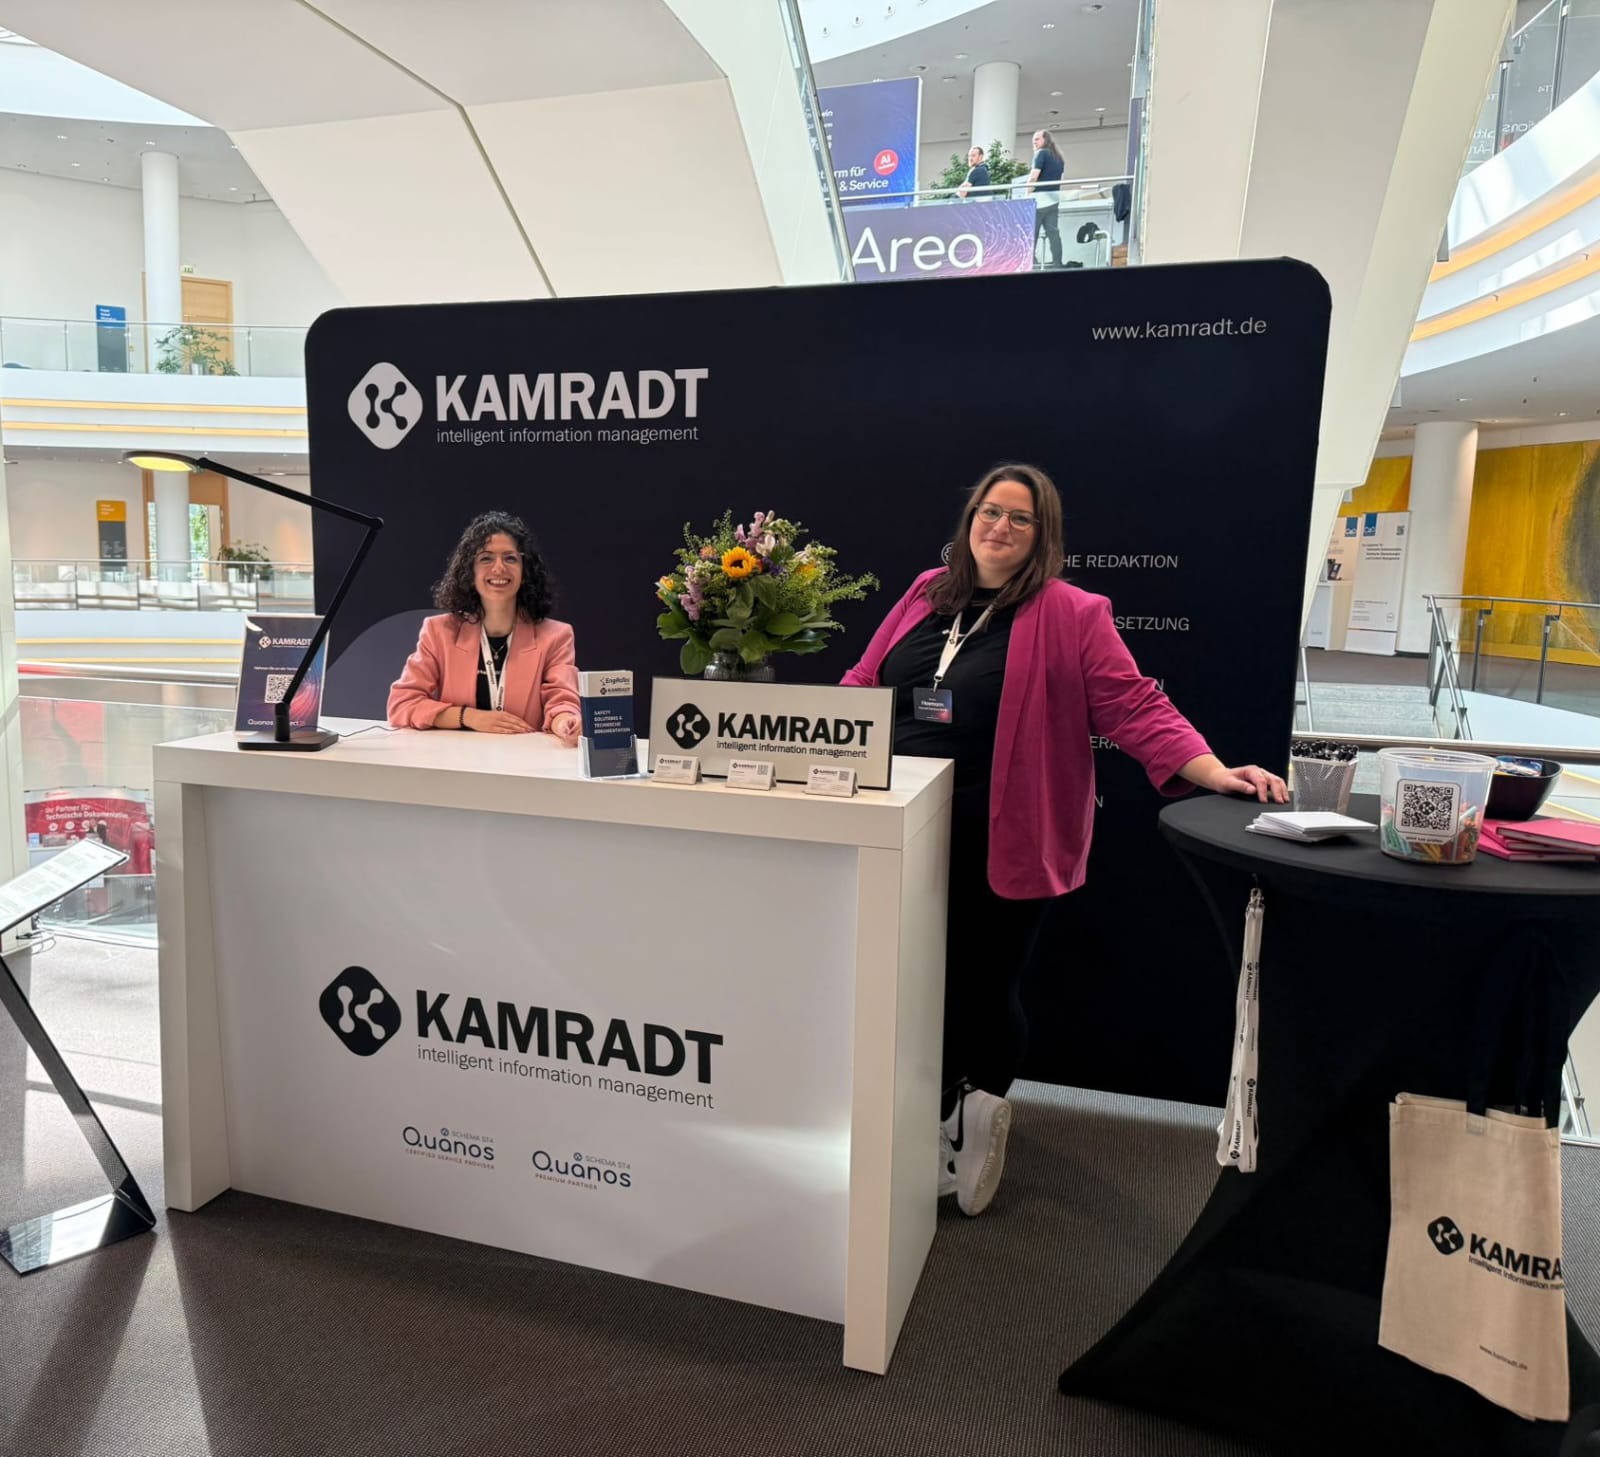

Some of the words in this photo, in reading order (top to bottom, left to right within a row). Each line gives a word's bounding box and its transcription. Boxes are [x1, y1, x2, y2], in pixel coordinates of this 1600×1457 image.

[849, 166, 867, 177] für
[839, 181, 847, 192] &
[849, 178, 889, 191] Service
[851, 226, 984, 273] Area
[1091, 316, 1267, 341] www.kamradt.de
[435, 368, 709, 422] KAMRADT
[436, 428, 505, 446] intelligent
[509, 427, 592, 443] information
[598, 426, 699, 445] management
[1086, 554, 1178, 568] REDAKTION
[272, 637, 313, 646] KAMRADT
[717, 711, 874, 747] KAMRADT
[716, 740, 757, 752] intelligent
[759, 743, 807, 755] information
[809, 747, 868, 759] management
[416, 989, 724, 1085] KAMRADT
[417, 1044, 495, 1072] intelligent
[499, 1060, 592, 1088] information
[598, 1074, 715, 1109] management
[402, 1126, 495, 1161] Quanos
[451, 1130, 480, 1142] SCHEMA
[437, 1153, 463, 1164] SERVICE
[585, 1155, 616, 1167] SCHEMA
[617, 1161, 631, 1169] ST4
[532, 1150, 631, 1188] Quanos
[535, 1172, 566, 1183] PREMIUM
[567, 1179, 598, 1190] PARTNER
